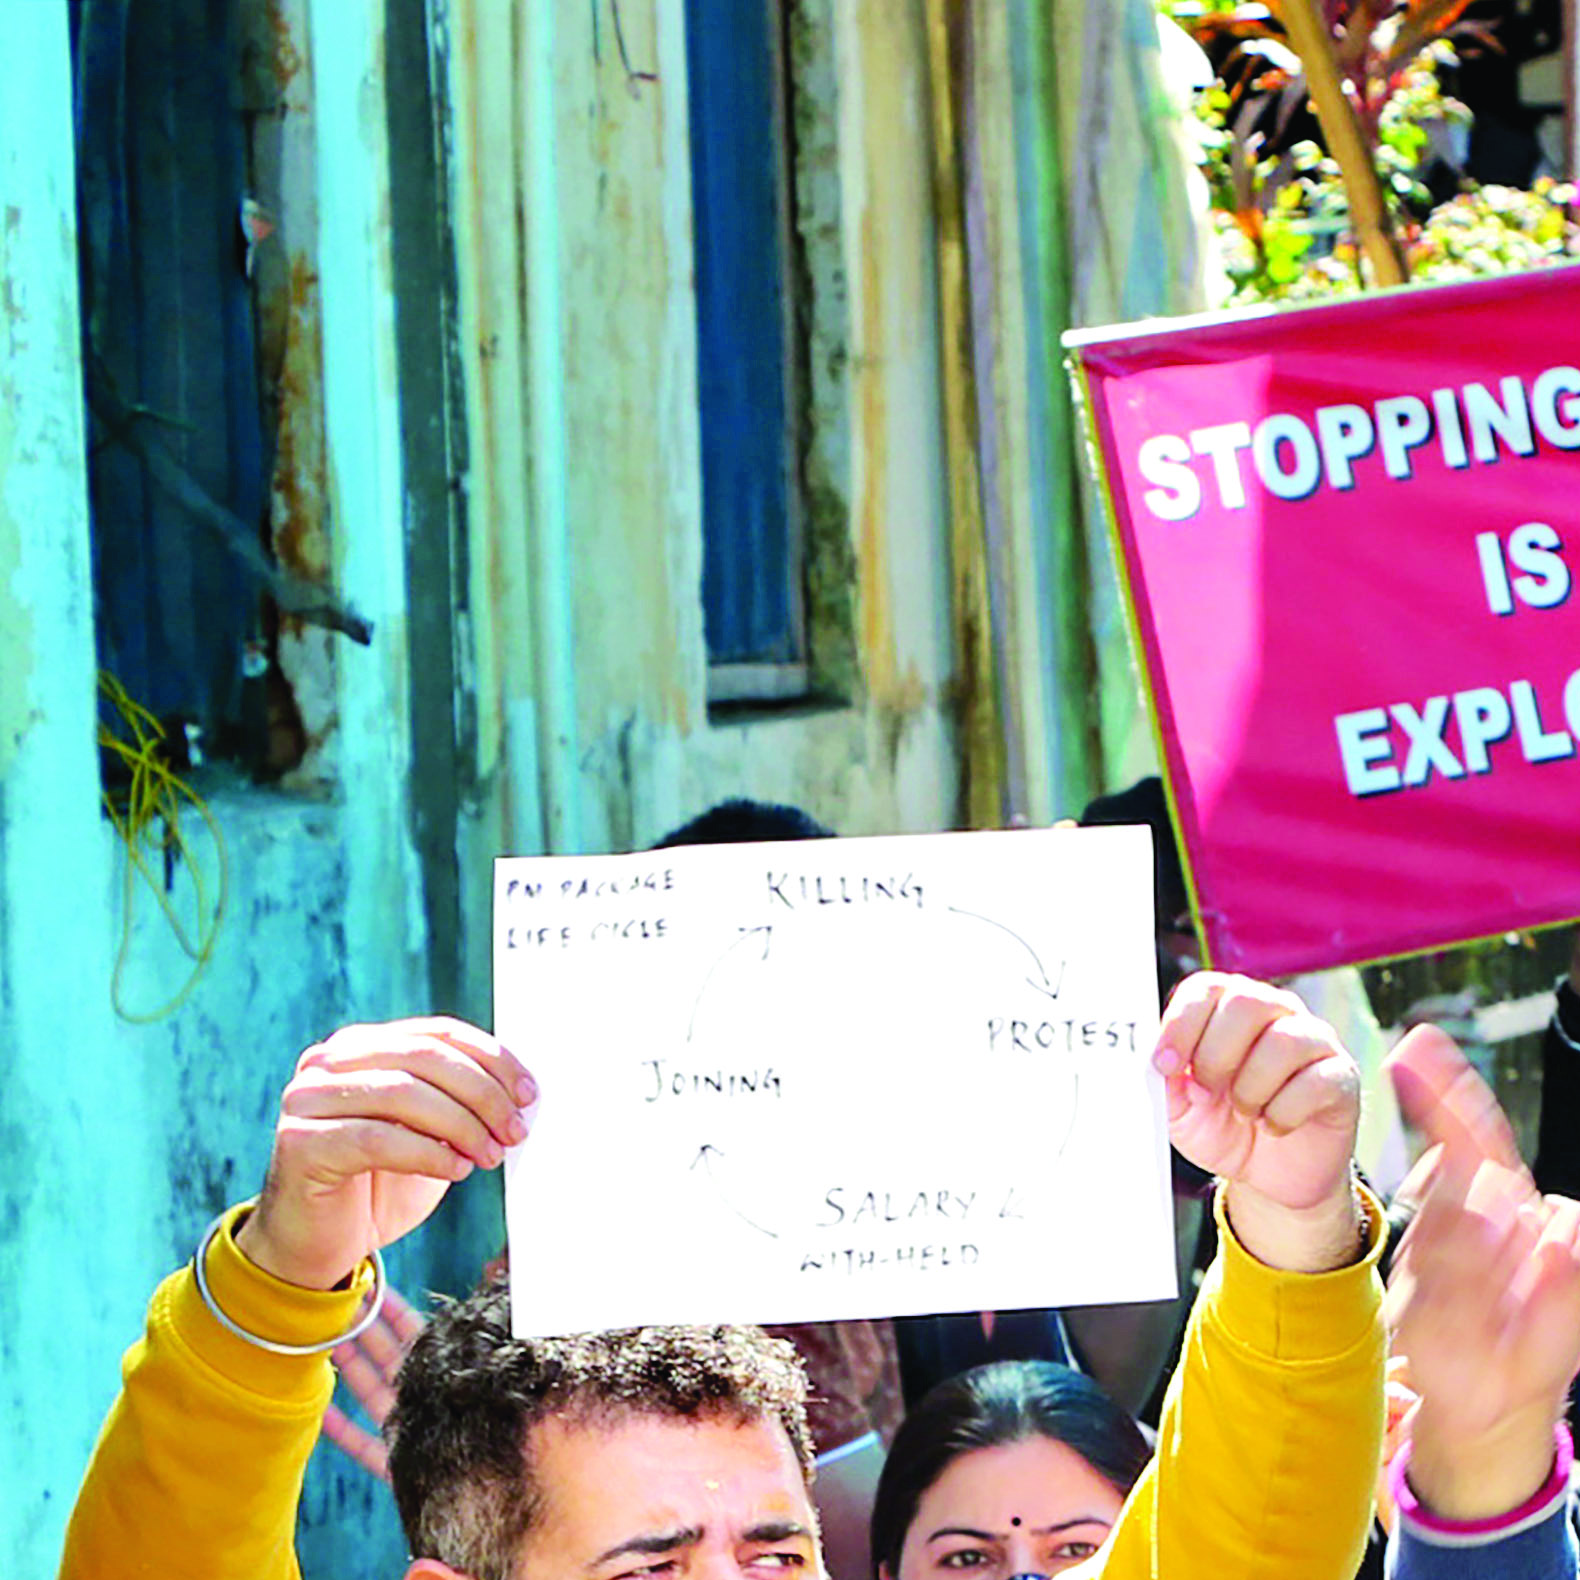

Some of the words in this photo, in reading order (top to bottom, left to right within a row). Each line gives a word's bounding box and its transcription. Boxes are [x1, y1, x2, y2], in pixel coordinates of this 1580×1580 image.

[1477, 522, 1574, 616] IS
[766, 871, 924, 910] KILLING
[507, 926, 572, 949] LIFE
[987, 1016, 1137, 1053] PROTEST
[641, 1058, 782, 1103] JOINING
[815, 1187, 977, 1229] SALARY
[800, 1244, 980, 1277] WITH-HELD
